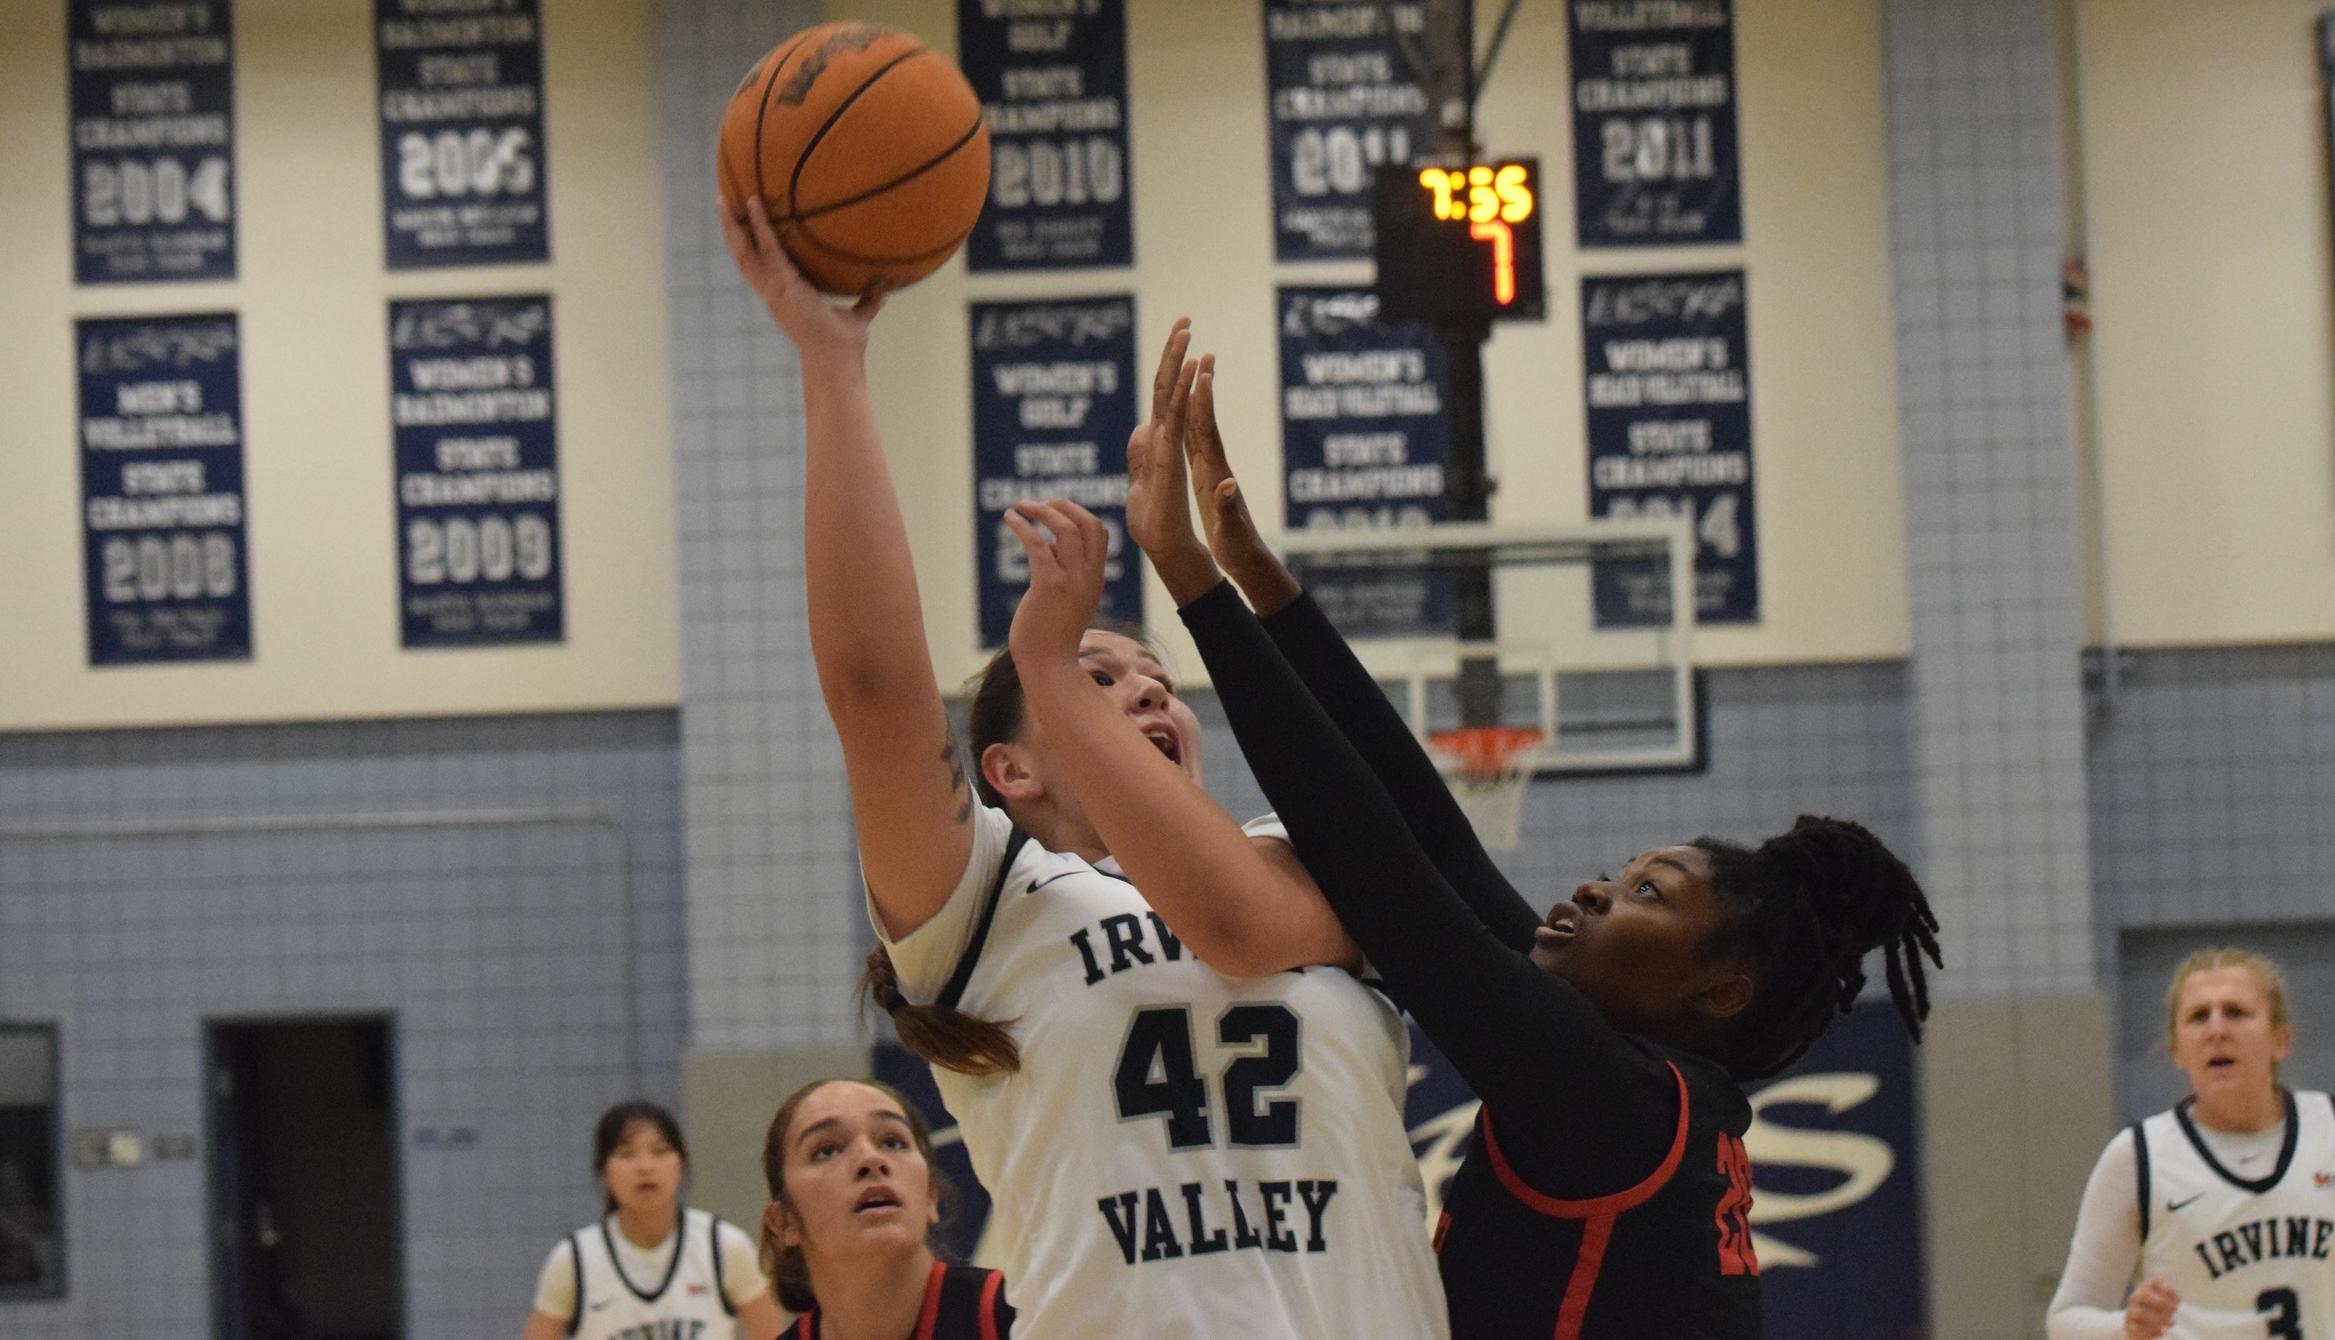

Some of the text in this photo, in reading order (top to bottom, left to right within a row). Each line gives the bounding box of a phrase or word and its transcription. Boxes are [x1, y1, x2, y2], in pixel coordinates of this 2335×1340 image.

[982, 98, 1121, 133] HAMPIONS
[992, 138, 1122, 207] 2010
[1470, 221, 1514, 304] 7
[407, 514, 551, 584] 2009
[1069, 910, 1198, 986] IRV
[1110, 1001, 1304, 1153] 42
[1098, 1179, 1338, 1265] VALLEY
[2195, 1215, 2334, 1281] IRVINE
